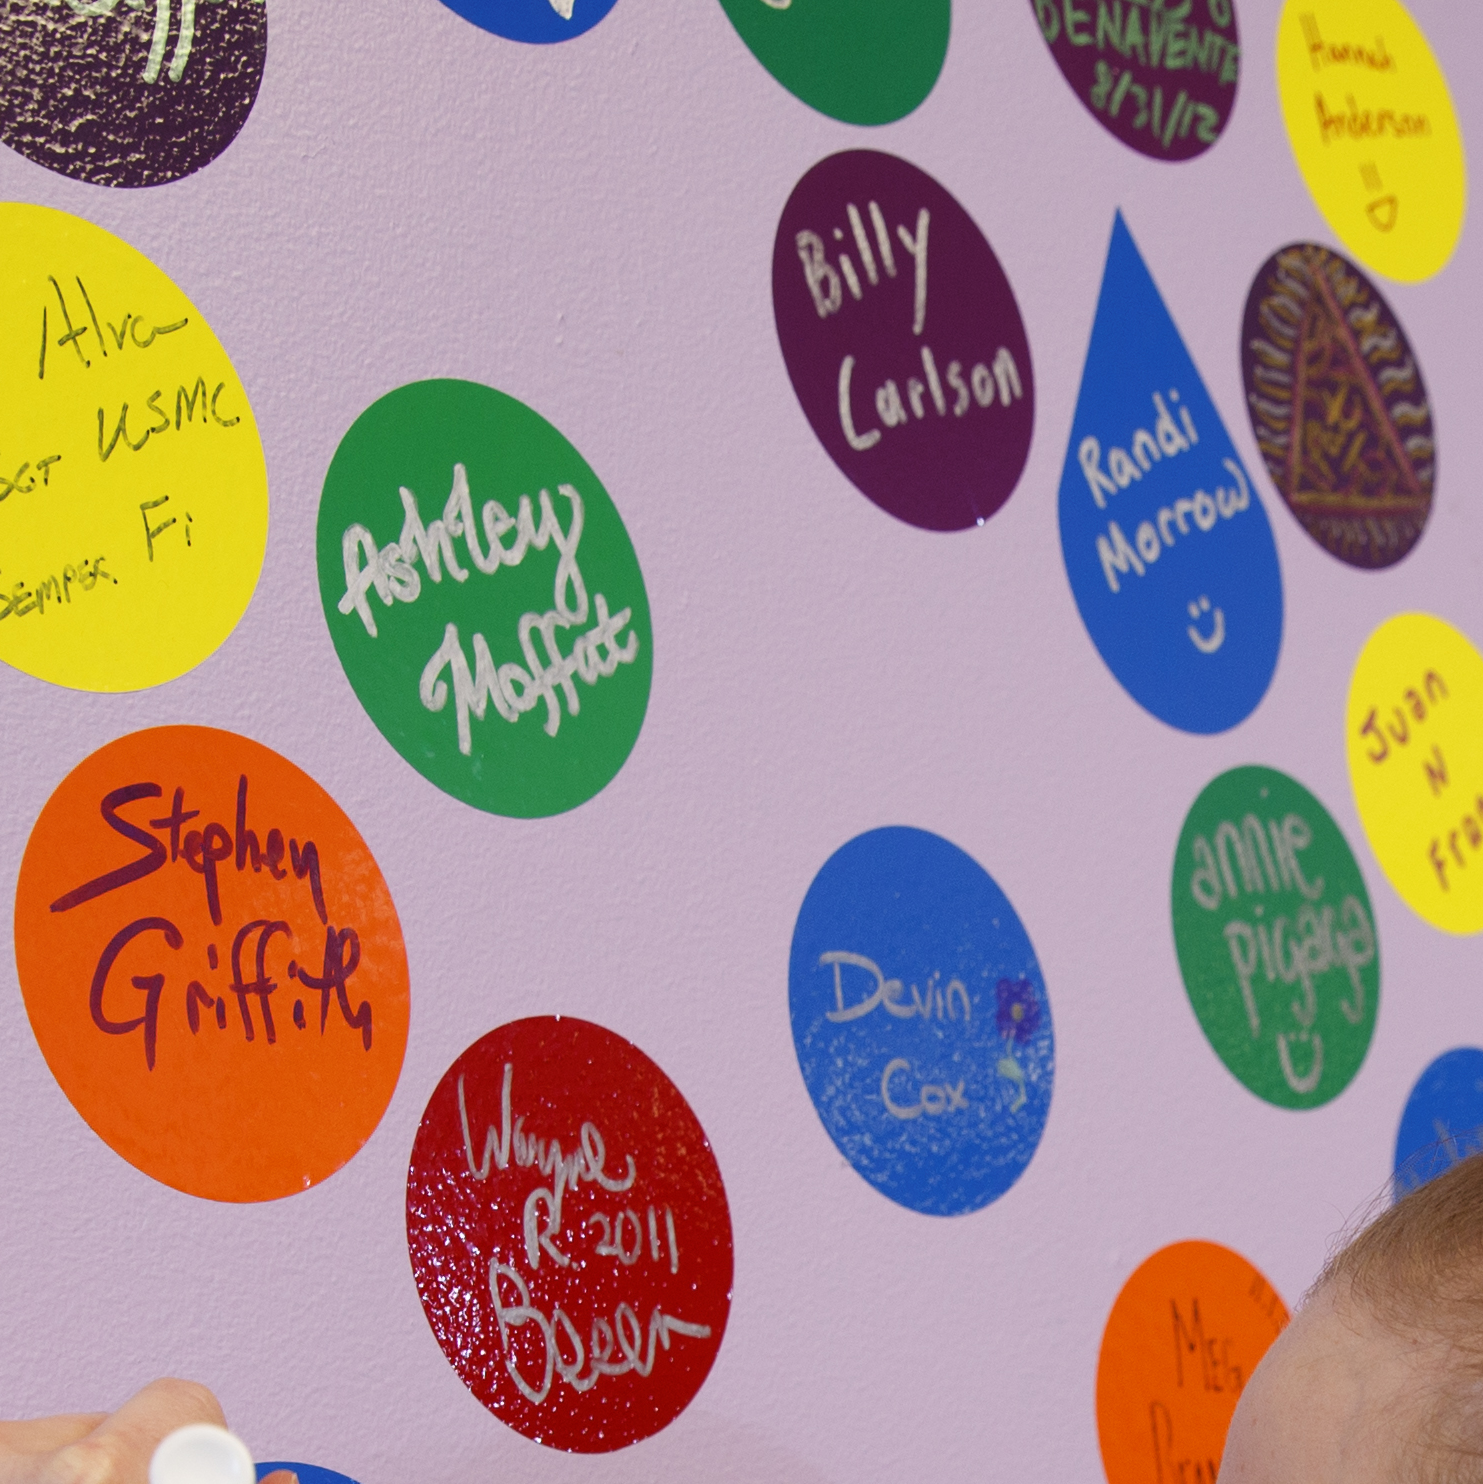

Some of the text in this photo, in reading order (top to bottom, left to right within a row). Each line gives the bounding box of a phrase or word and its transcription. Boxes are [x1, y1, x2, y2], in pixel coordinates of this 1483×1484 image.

[796, 201, 930, 335] Billy
[96, 376, 241, 463] USMC
[838, 346, 1022, 451] Carlson
[1078, 388, 1198, 508] Randi
[338, 463, 588, 637] Ashley
[1098, 458, 1250, 592] Morrow
[1359, 668, 1452, 764] Juan
[49, 774, 328, 925] Stephen
[89, 916, 373, 1072] Griffith
[819, 949, 972, 1023] Devin
[881, 1057, 970, 1120] Cox
[458, 1062, 637, 1240] Wayne
[589, 1203, 680, 1276] 2011
